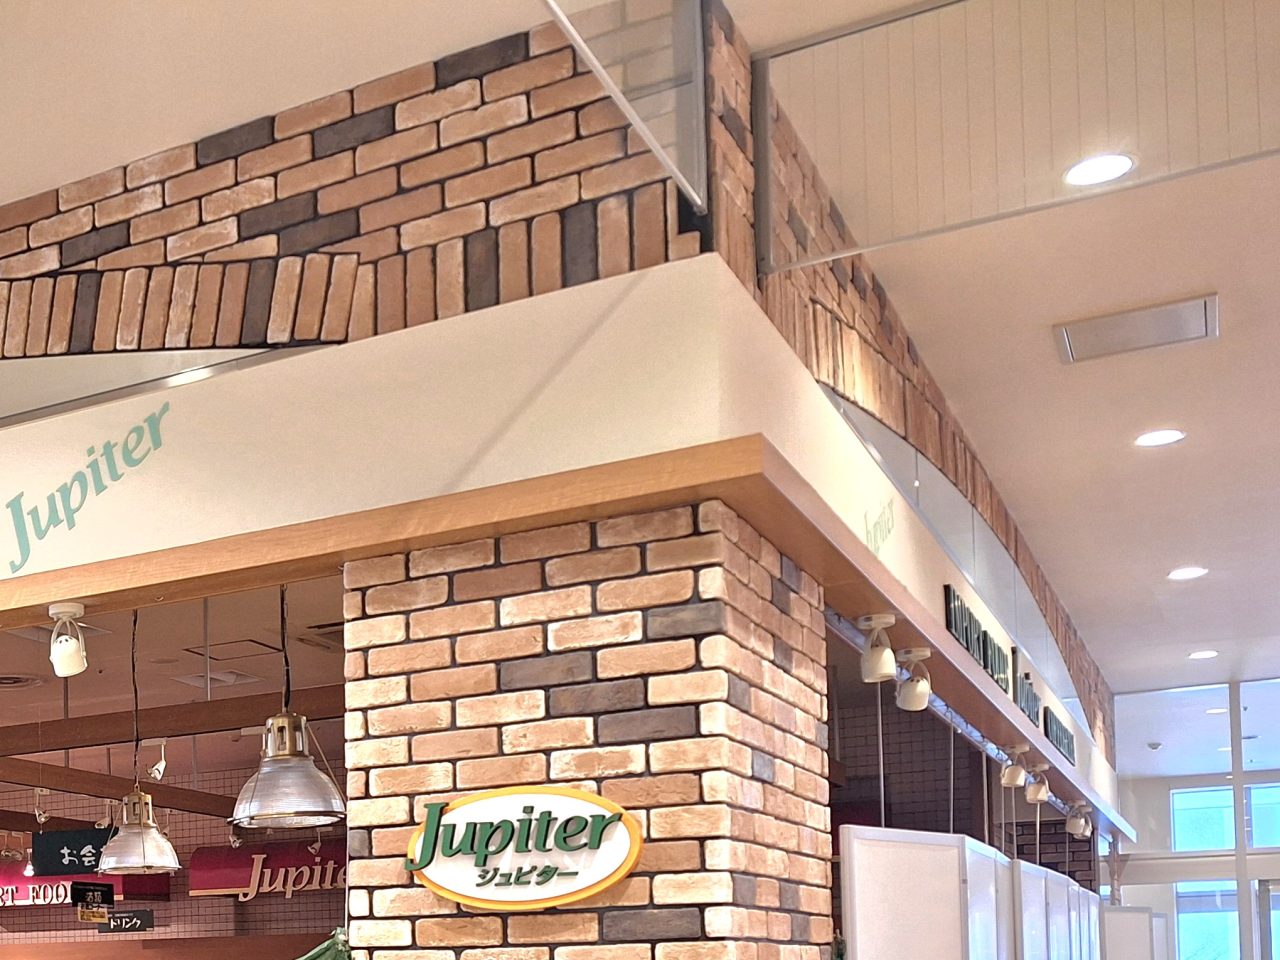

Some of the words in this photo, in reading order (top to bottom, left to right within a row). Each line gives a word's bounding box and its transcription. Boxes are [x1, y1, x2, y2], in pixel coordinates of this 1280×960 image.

[5, 401, 170, 574] Jupiter
[60, 844, 105, 866] お会
[404, 802, 623, 871] Jupiter
[238, 854, 346, 902] Jupite
[476, 865, 579, 887] ジュピター
